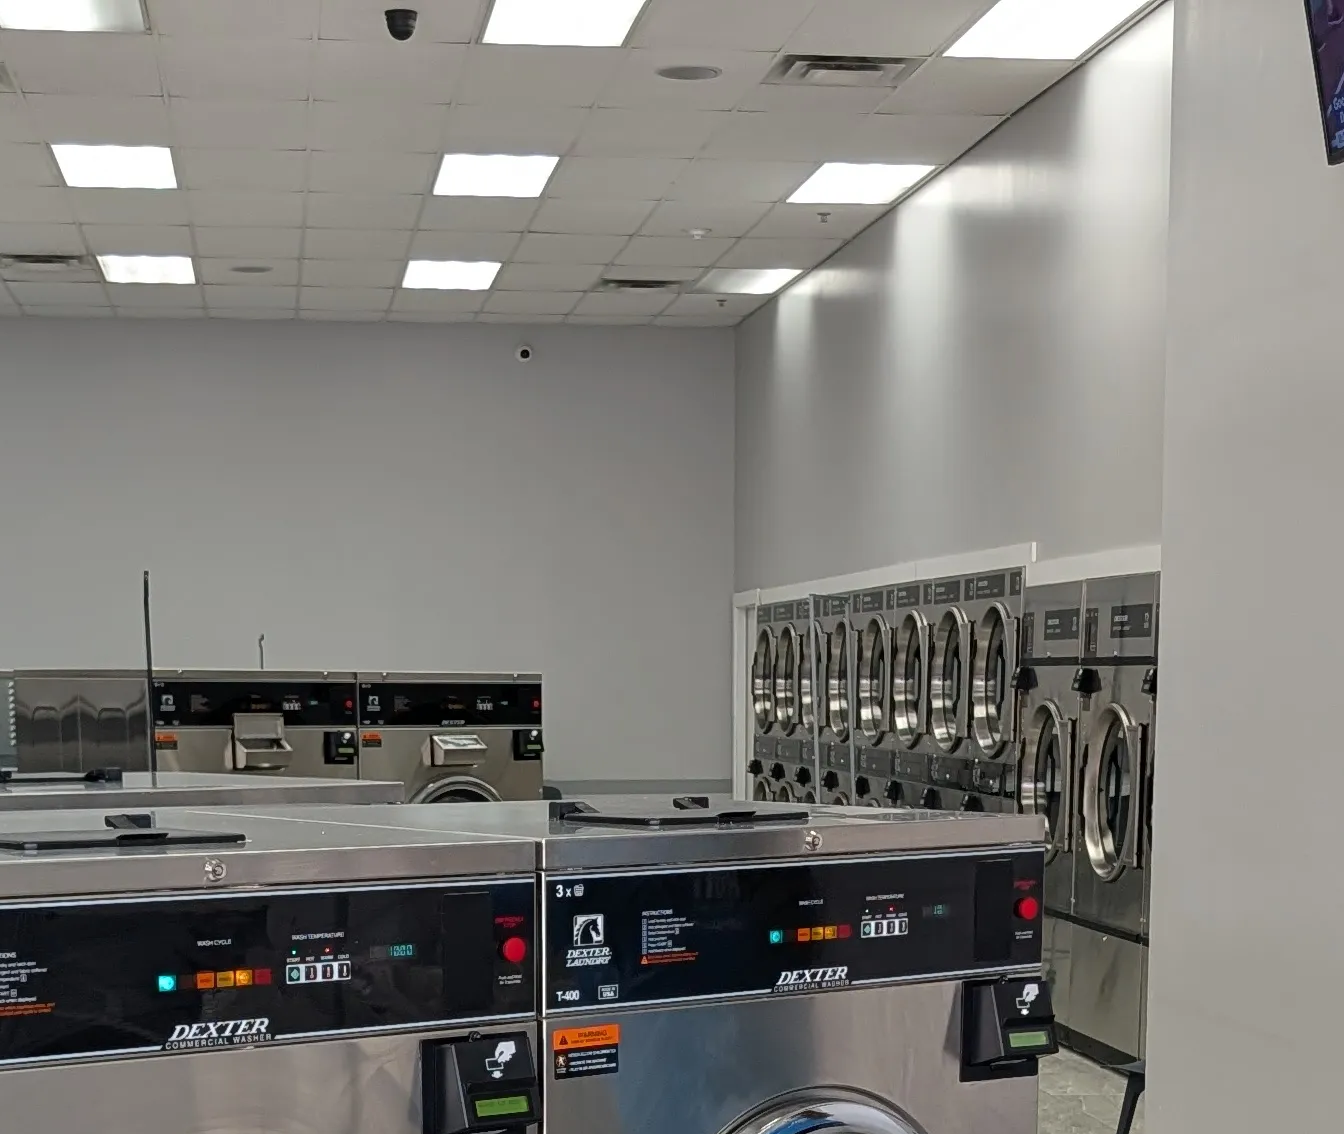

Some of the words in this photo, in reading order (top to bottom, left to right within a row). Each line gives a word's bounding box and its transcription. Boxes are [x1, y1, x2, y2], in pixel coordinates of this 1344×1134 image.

[556, 885, 563, 897] 3
[566, 889, 571, 897] x
[566, 947, 610, 959] DEXTER
[566, 956, 611, 967] LAUNDRY
[776, 966, 848, 985] DEXTER
[556, 990, 579, 1001] T-400
[168, 1018, 270, 1041] DEXTER
[165, 1036, 229, 1050] COMMERCIAL
[233, 1033, 272, 1044] WASHER
